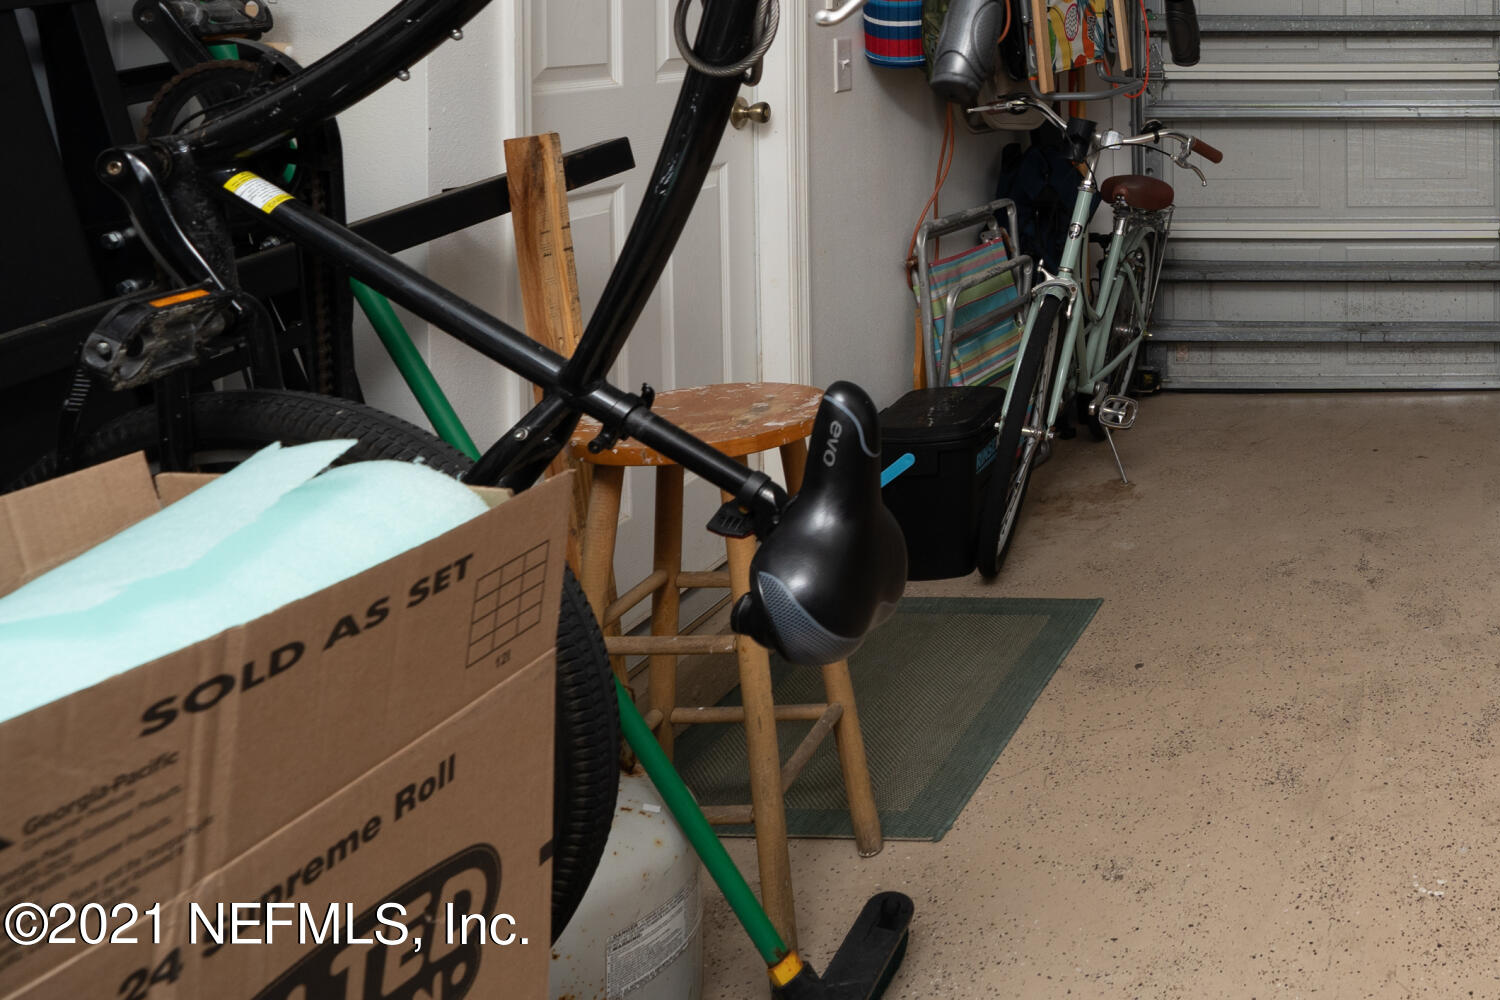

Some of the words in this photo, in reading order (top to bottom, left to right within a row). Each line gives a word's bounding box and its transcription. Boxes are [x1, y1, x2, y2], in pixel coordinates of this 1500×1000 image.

[823, 420, 843, 467] evo
[138, 640, 306, 738] SOLD
[321, 596, 391, 652] AS
[405, 552, 475, 609] SET
[393, 752, 456, 823] Roll
